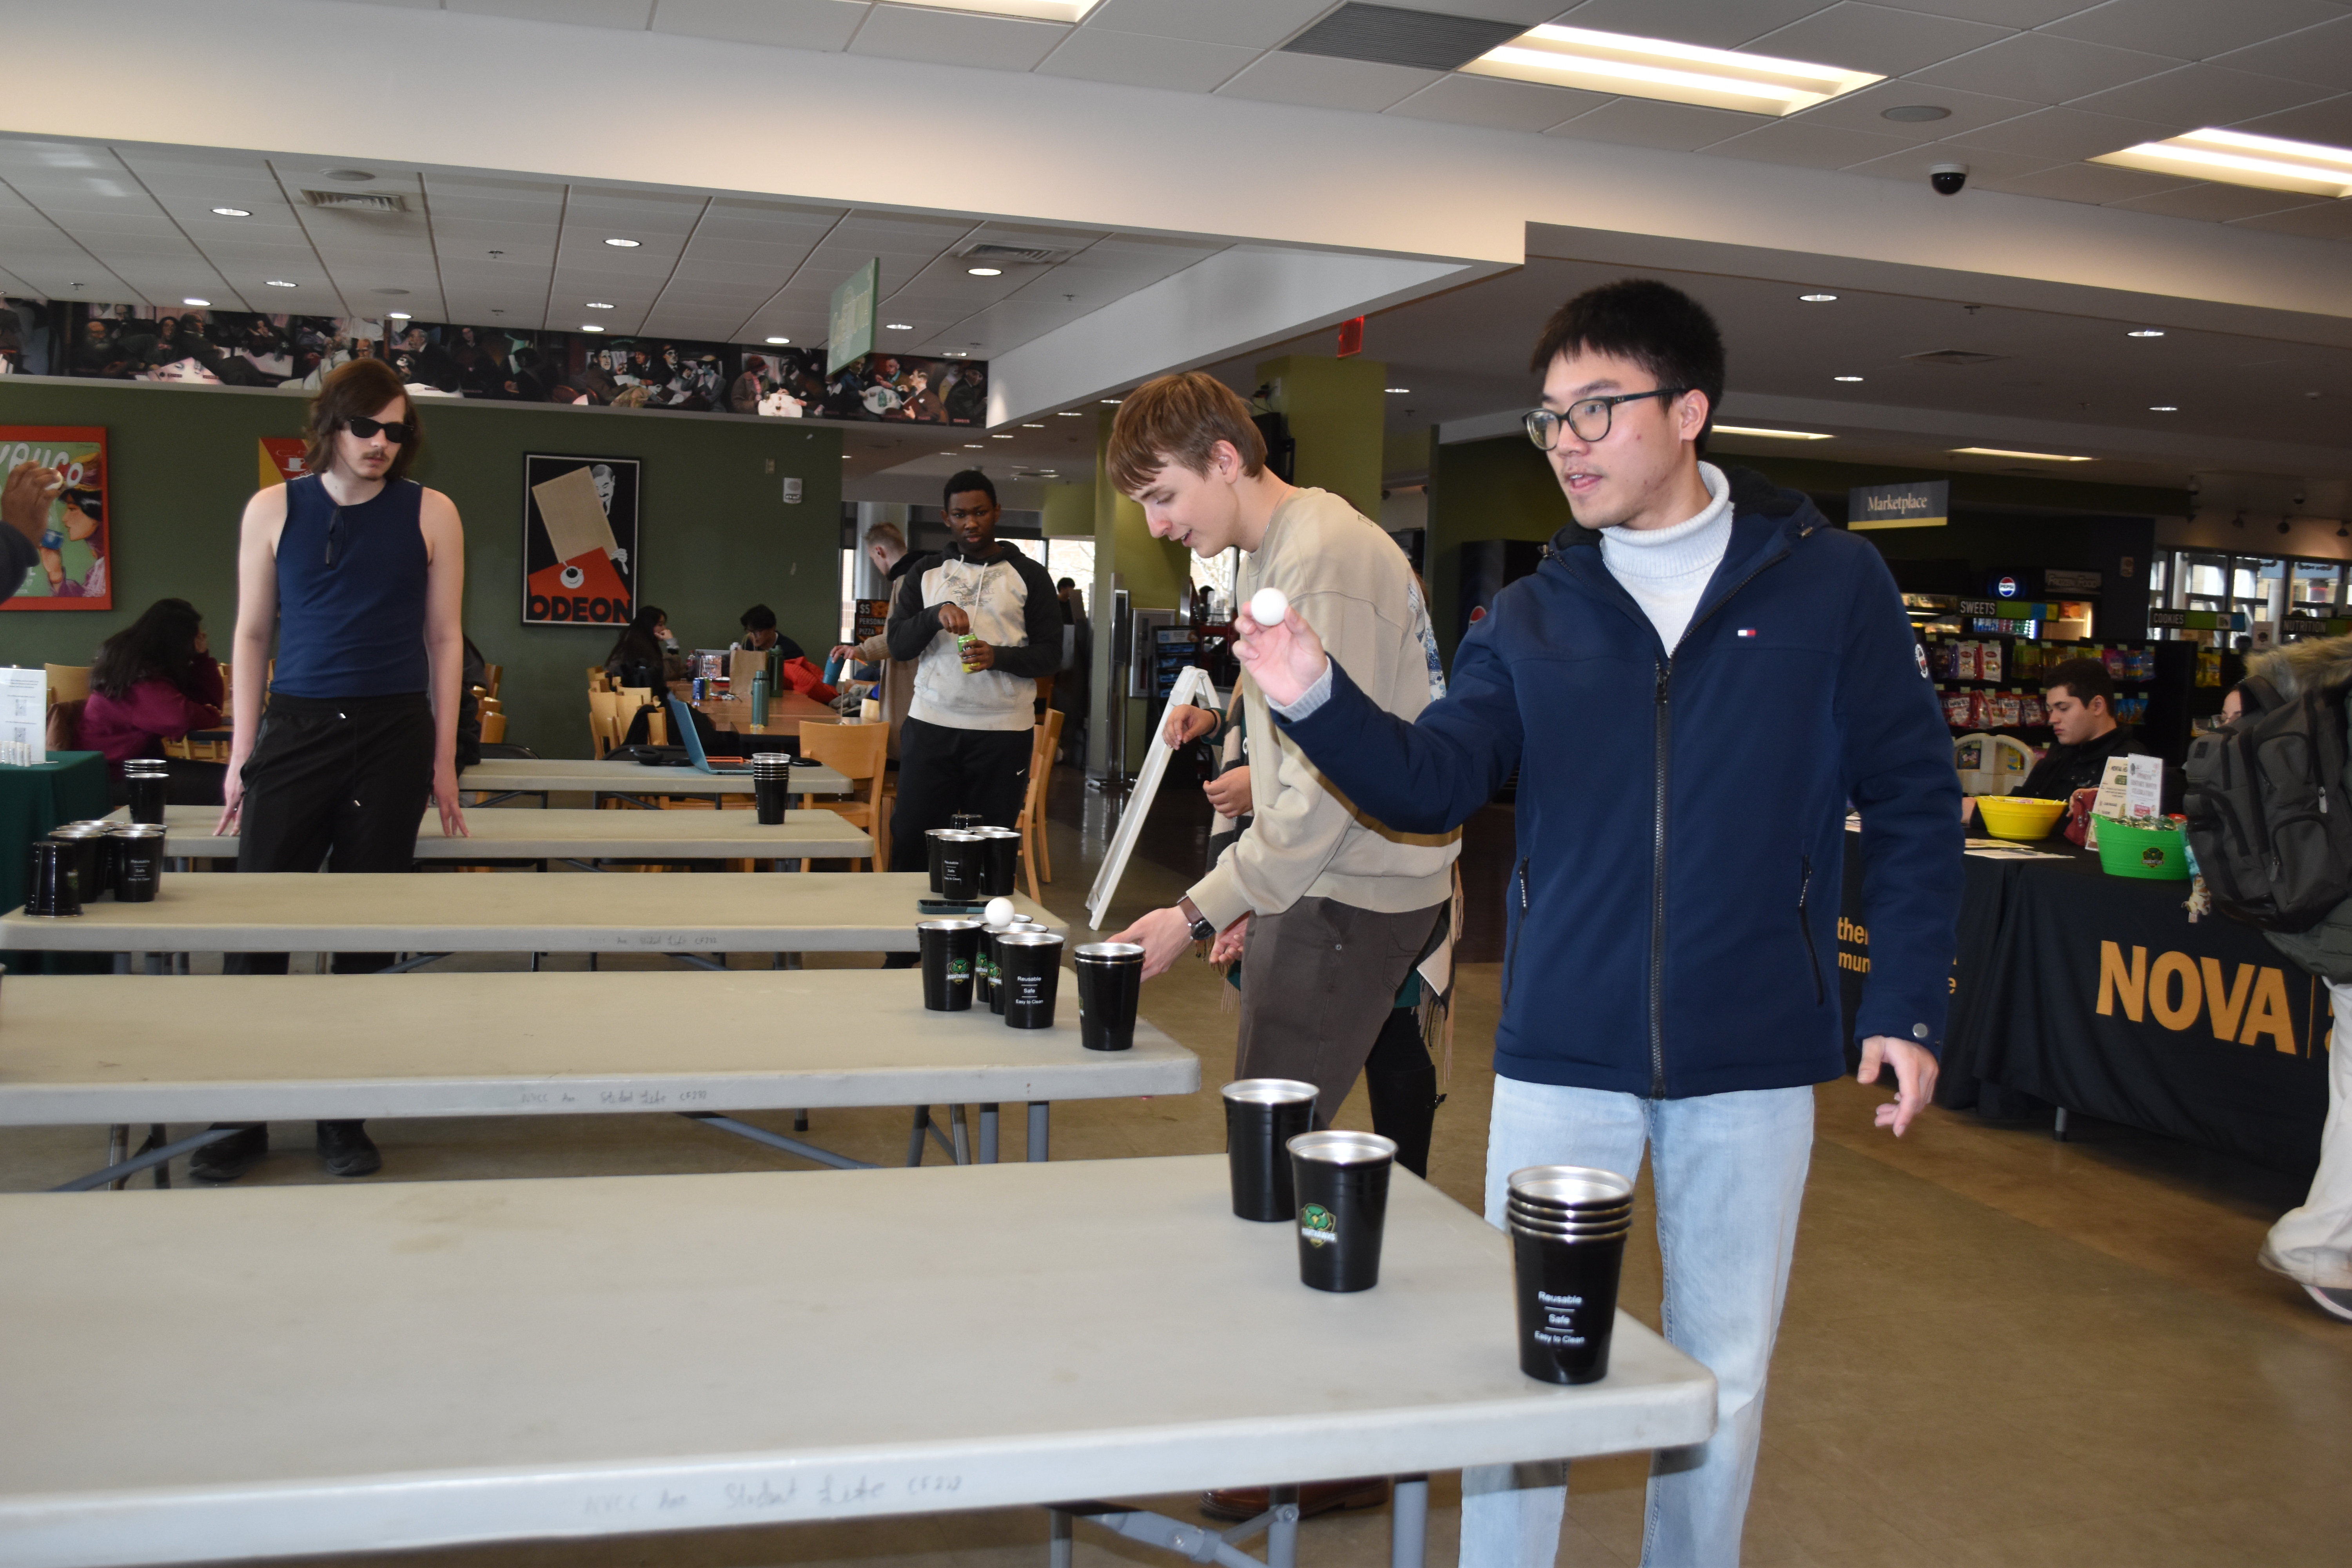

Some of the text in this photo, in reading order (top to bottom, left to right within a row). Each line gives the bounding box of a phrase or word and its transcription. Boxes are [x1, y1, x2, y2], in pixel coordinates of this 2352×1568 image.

[1867, 493, 1927, 514] Marketplace
[529, 595, 632, 623] ODEON
[860, 604, 870, 614] $5
[1960, 601, 1995, 615] SWEETS
[2153, 613, 2184, 624] COOKIES
[2283, 620, 2326, 633] NUTRITION
[2096, 940, 2296, 1055] NOVA
[1538, 1291, 1582, 1303] Reusable
[1549, 1314, 1570, 1324] Safe
[1534, 1330, 1552, 1343] Easy
[1562, 1335, 1585, 1343] Clean
